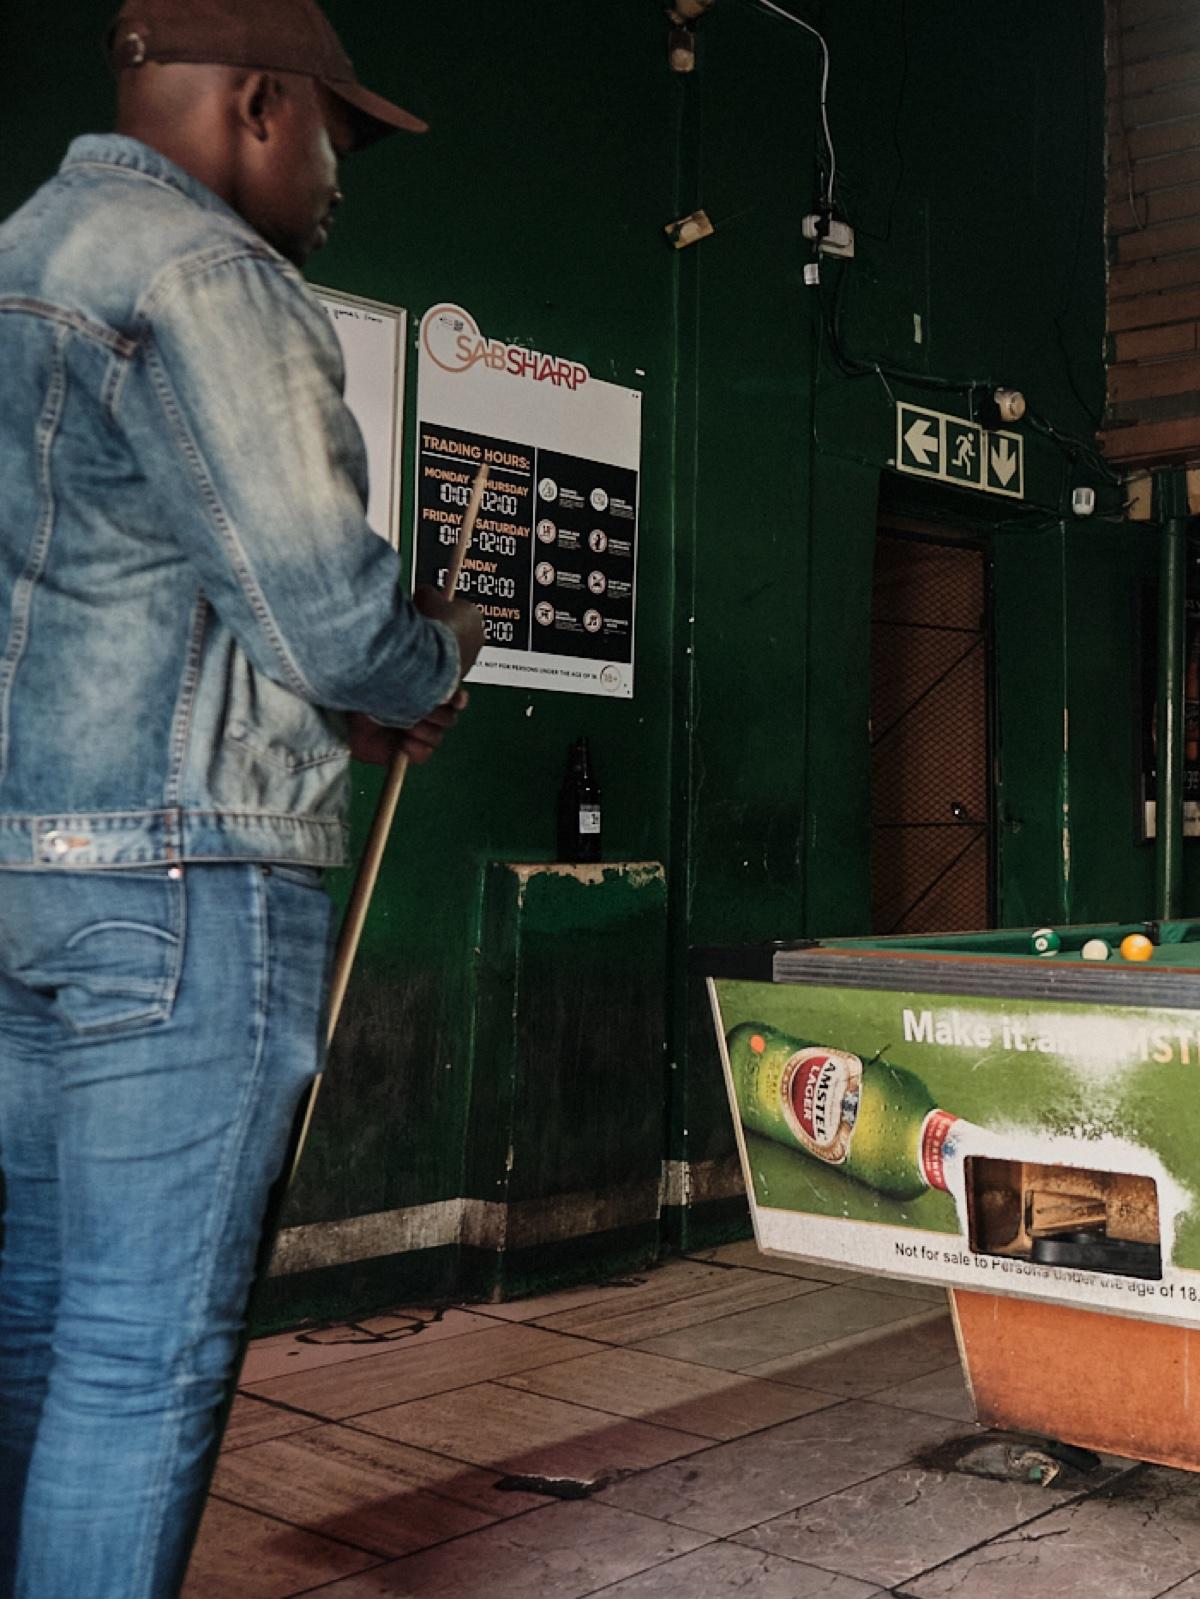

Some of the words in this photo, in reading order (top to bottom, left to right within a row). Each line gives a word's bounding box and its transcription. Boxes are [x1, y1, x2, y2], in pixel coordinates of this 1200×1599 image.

[422, 434, 482, 459] TRADING
[484, 448, 531, 470] HOURS:
[424, 466, 471, 484] MONDAY
[484, 479, 529, 497] HURSDAY
[423, 508, 464, 524] FRIDAY
[475, 518, 531, 537] SATURDAY
[461, 558, 498, 573] UNDAY
[475, 604, 521, 620] OLIDAYS
[903, 1008, 993, 1049] Make
[1002, 1015, 1029, 1052] it
[803, 1065, 822, 1121] LAGER
[815, 1062, 836, 1137] AMSTEL
[895, 1242, 918, 1258] Not
[921, 1245, 939, 1262] for
[943, 1250, 970, 1267] sale
[974, 1253, 988, 1269] to
[1127, 1280, 1155, 1298] age
[1160, 1283, 1174, 1297] of
[1180, 1286, 1200, 1303] 18.
